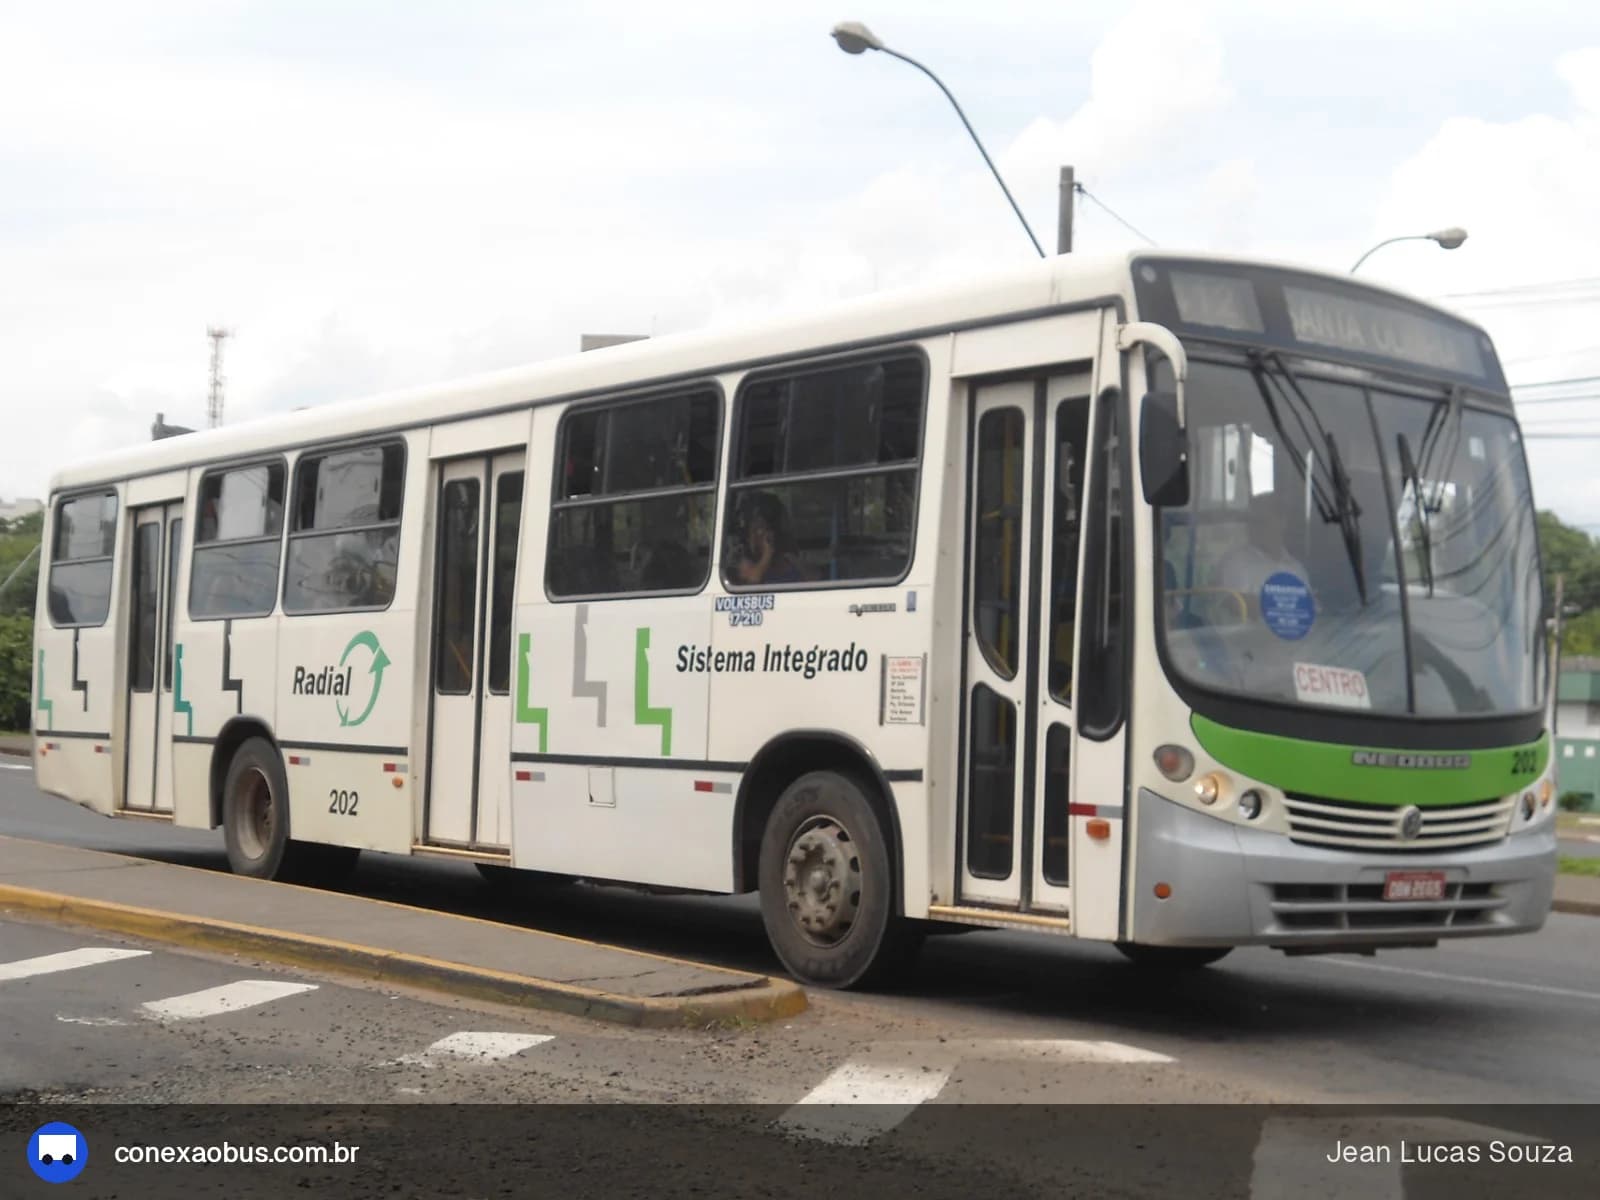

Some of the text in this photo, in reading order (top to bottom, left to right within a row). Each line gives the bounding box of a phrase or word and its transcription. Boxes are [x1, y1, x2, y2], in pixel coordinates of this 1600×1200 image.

[716, 596, 773, 610] VOLKSBUS
[676, 642, 868, 679] Sistema Integrado
[293, 666, 352, 696] Radial
[1296, 666, 1366, 698] CENTRO
[1511, 751, 1537, 774] 202
[328, 789, 359, 816] 202
